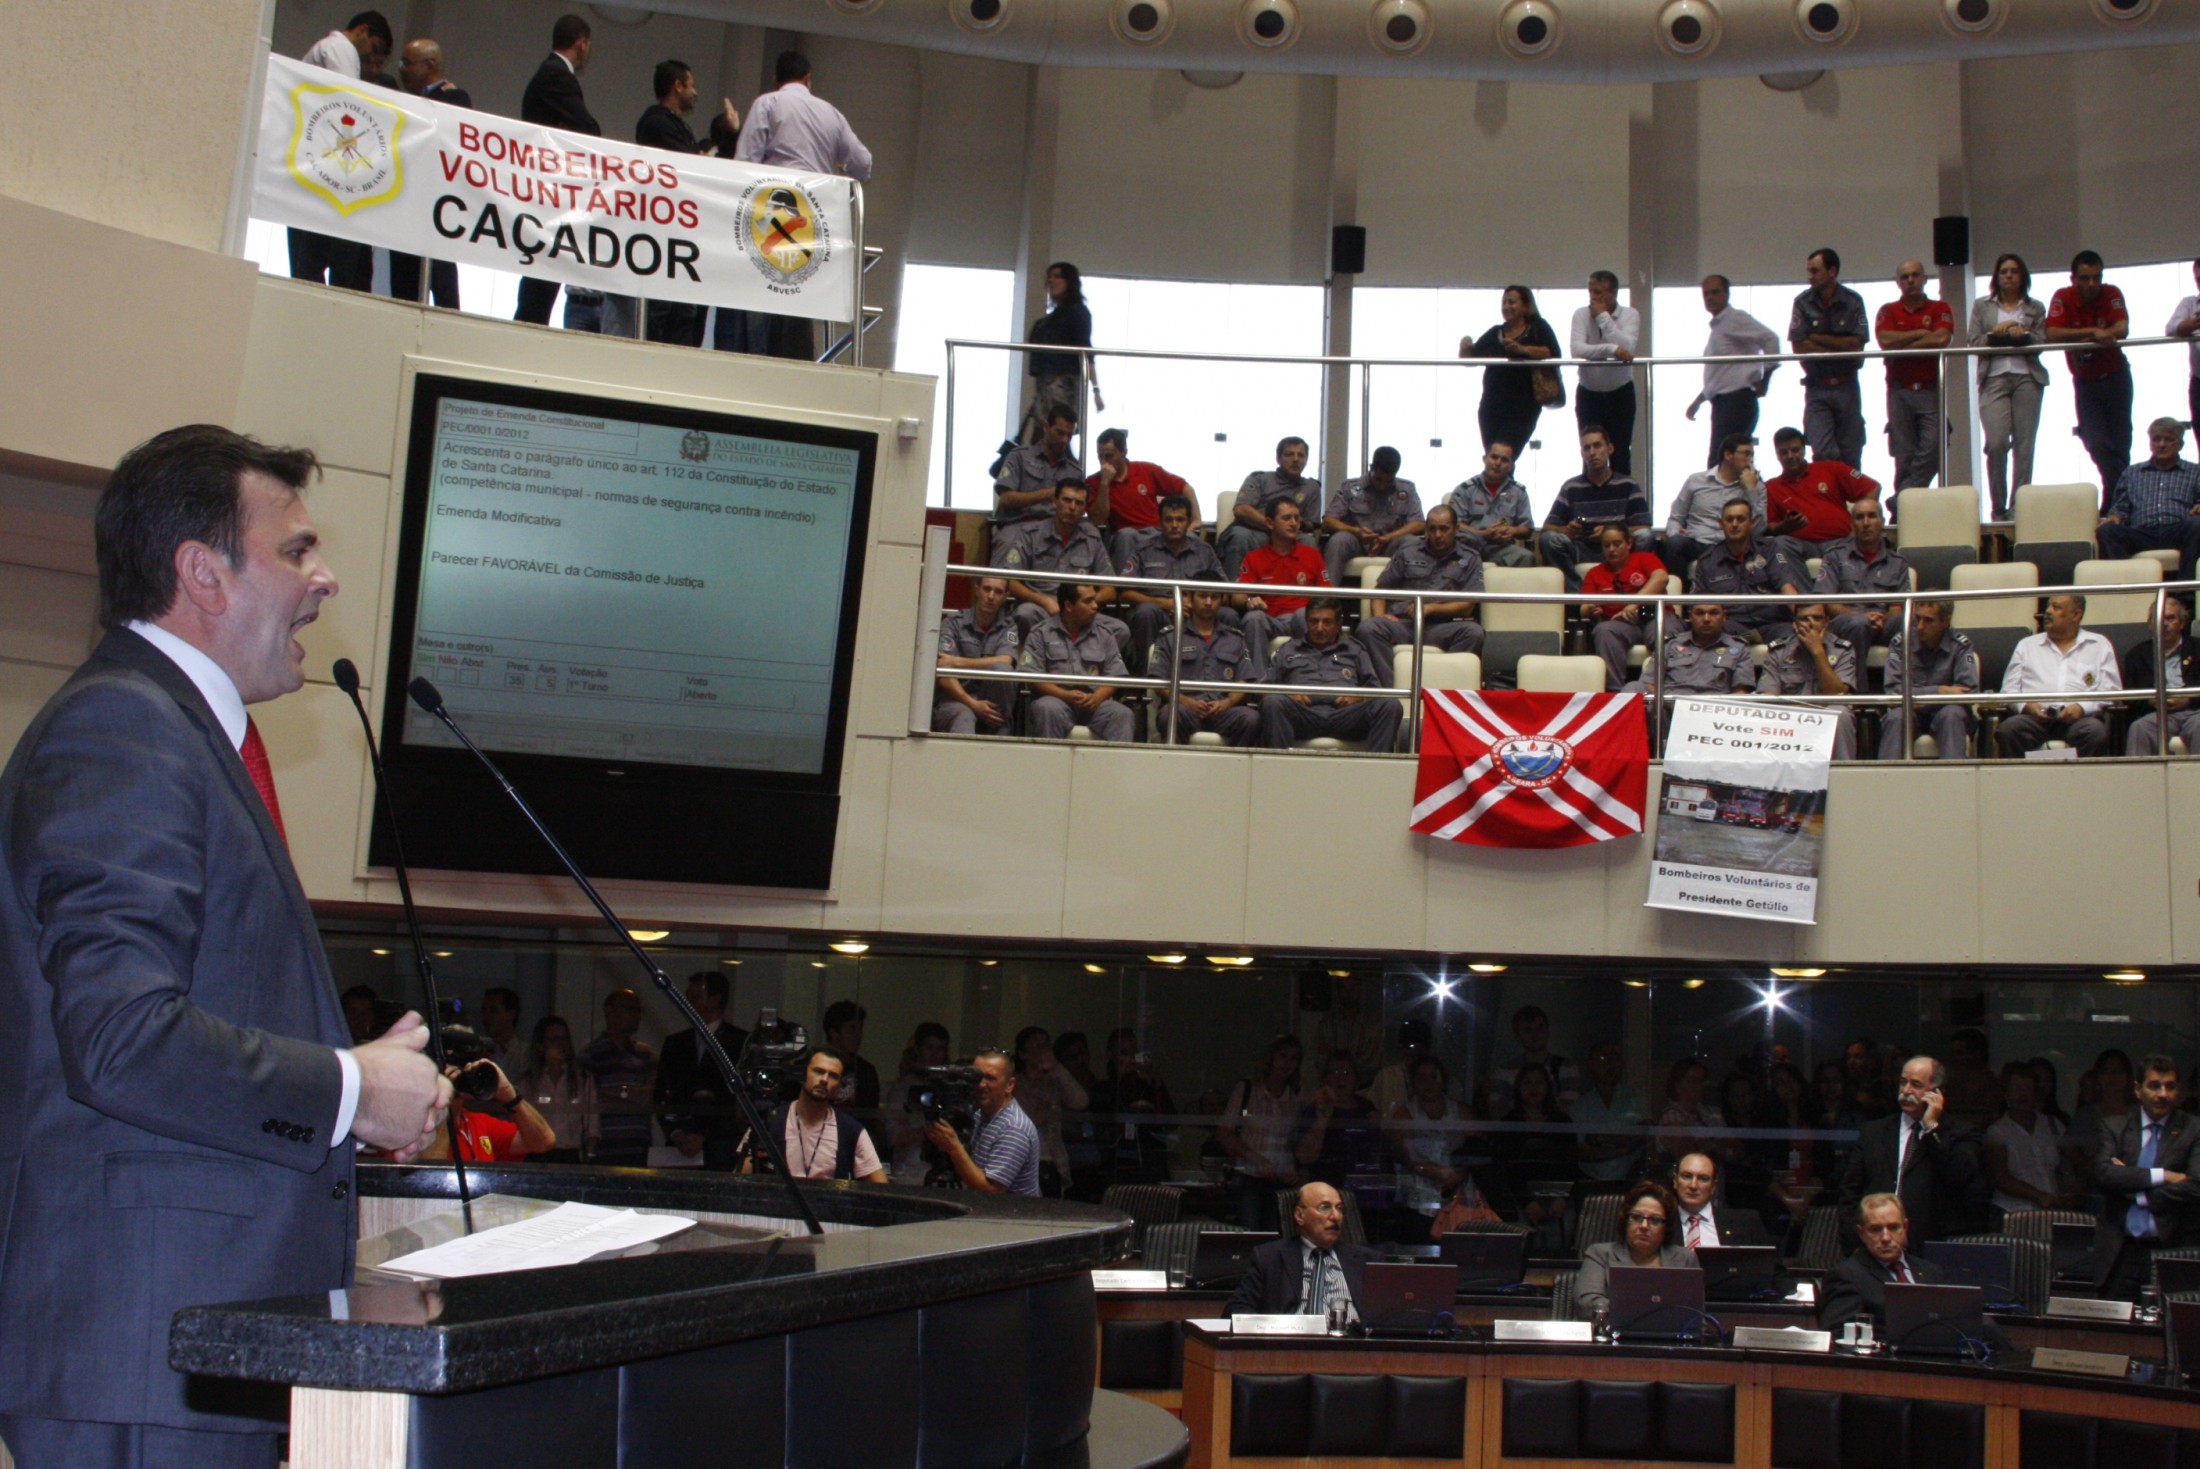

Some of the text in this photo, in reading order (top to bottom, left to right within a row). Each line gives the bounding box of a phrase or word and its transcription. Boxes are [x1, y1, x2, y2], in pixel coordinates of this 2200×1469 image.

[459, 121, 679, 189] BOMBEIROS
[361, 168, 388, 192] BRASIL
[439, 150, 699, 229] VOLUNTÁRIOS
[733, 199, 745, 252] BOMBEIROS
[806, 191, 824, 219] SANTA
[432, 194, 702, 283] CAÇADOR
[766, 283, 801, 295] ABVESC
[444, 403, 605, 430] Projeto de Emenda Constitucional
[441, 458, 457, 469] de
[461, 459, 496, 473] Santa
[713, 452, 851, 475] DO ESTADO DE SANTA CATARINA
[783, 446, 851, 464] LEGISLATIVA
[443, 441, 511, 460] Acrescenta
[514, 452, 522, 460] o
[526, 450, 583, 467] parágrafo
[587, 456, 619, 471] único
[622, 463, 637, 473] ao
[664, 466, 685, 479] 112
[688, 468, 702, 480] da
[706, 471, 776, 489] Constituição
[779, 479, 794, 491] do
[797, 481, 836, 496] Estado
[440, 473, 521, 492] (competência
[525, 482, 583, 499] municipal
[595, 491, 638, 505] normas
[643, 495, 657, 506] de
[661, 498, 721, 513] segurança
[725, 504, 760, 517] contra
[764, 508, 816, 526] incêndio)
[436, 504, 561, 528] Emenda Modificativa
[431, 551, 704, 590] Parecer FAVORÁVEL da Comissão de Justiça
[417, 636, 446, 649] Mesa
[1689, 703, 1823, 726] DEPUTADO (A)
[1712, 722, 1794, 737] Vote SIM
[1687, 734, 1814, 752] PEC 001/2012
[1658, 866, 1811, 892] Bombeiros Voluntários de
[1678, 891, 1789, 912] Presidente Getúlio
